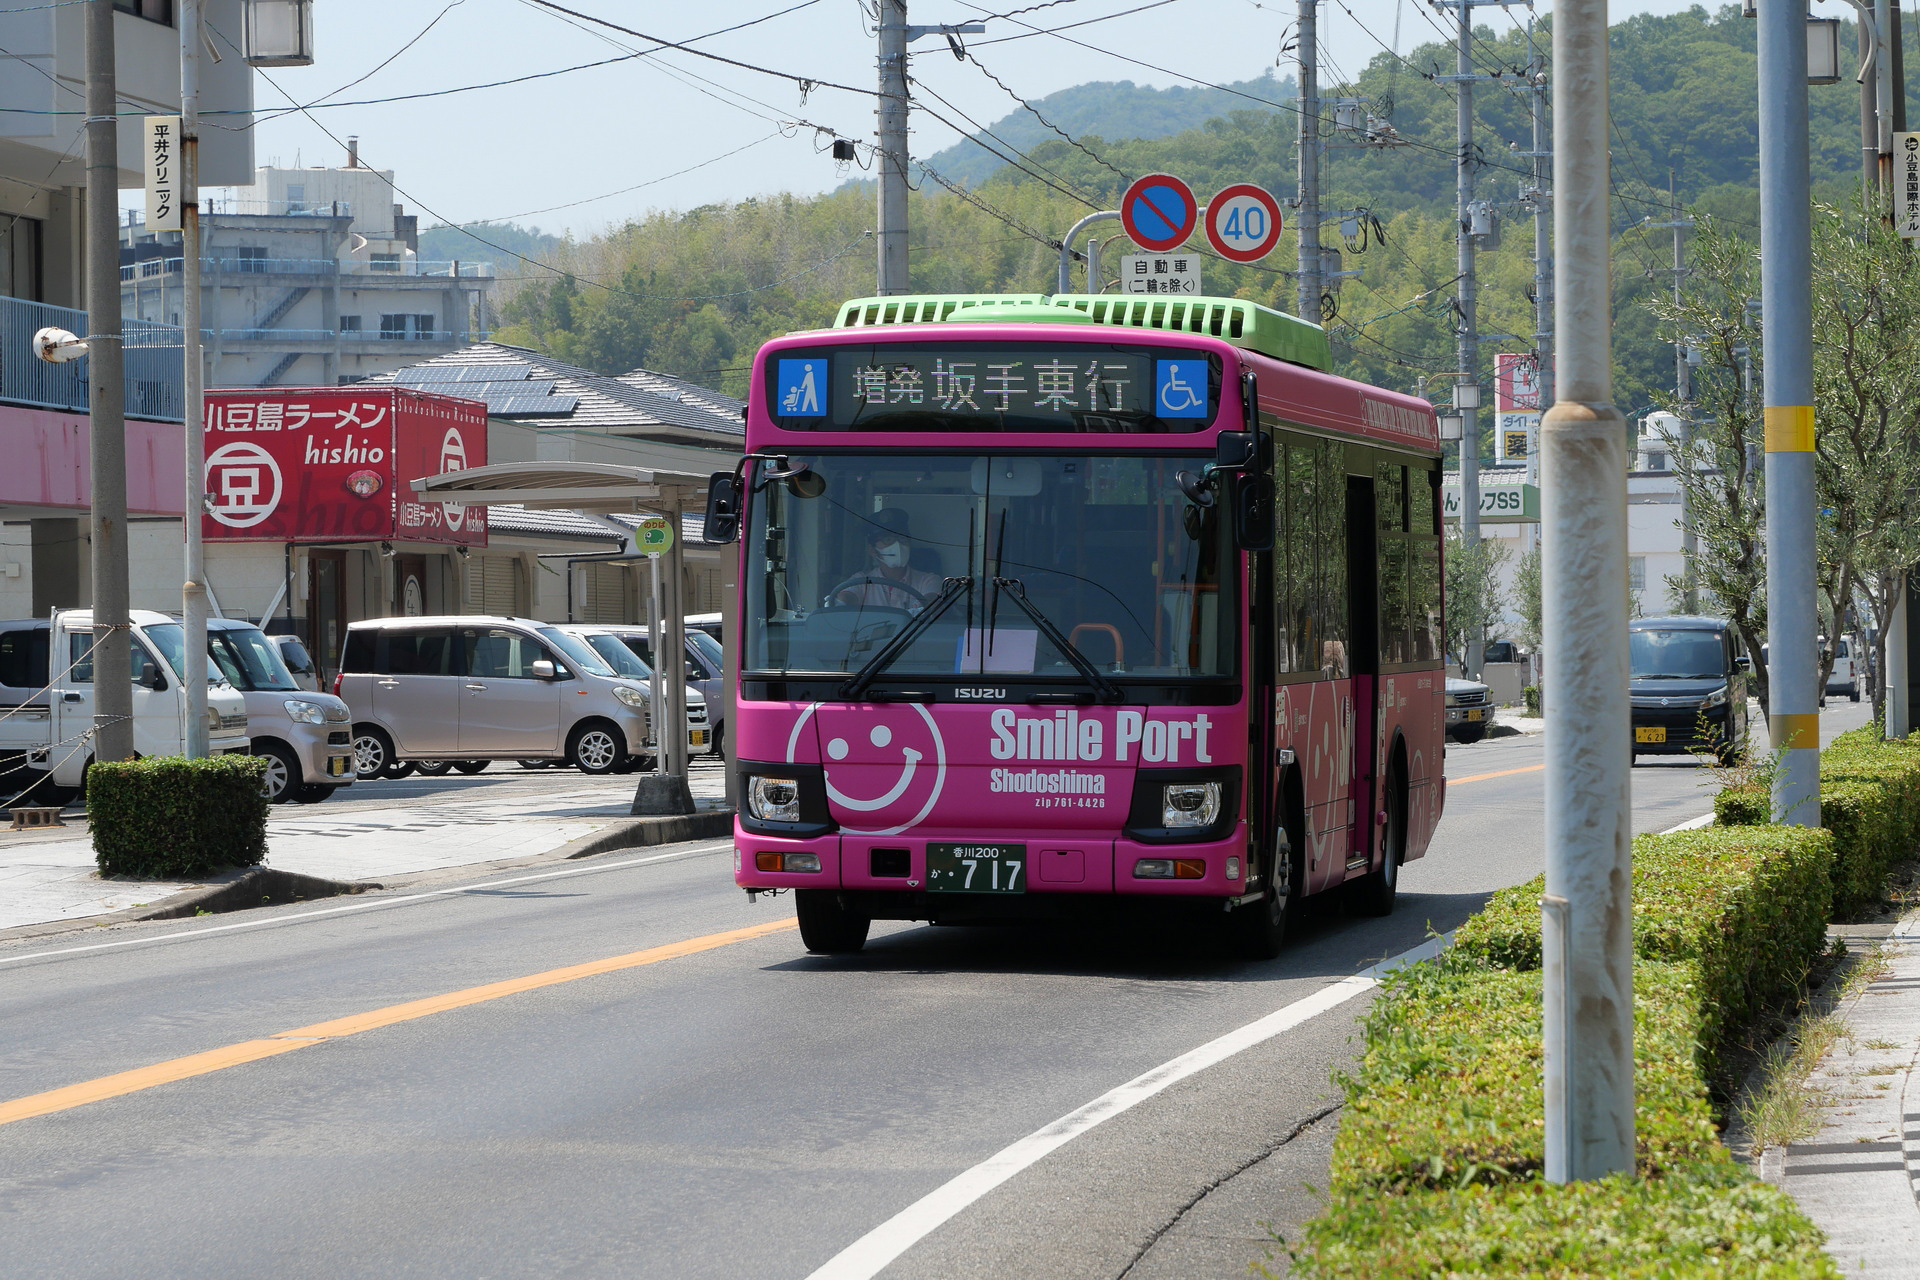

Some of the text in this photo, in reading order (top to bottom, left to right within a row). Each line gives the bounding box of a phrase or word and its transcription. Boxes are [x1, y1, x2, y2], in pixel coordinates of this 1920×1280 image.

[153, 124, 171, 220] 平井クリニック
[1906, 152, 1919, 232] 小豆島国際ホテル
[1223, 206, 1264, 241] 40
[1134, 258, 1188, 275] 自動車
[1128, 277, 1196, 294] (二輪を除く)
[204, 402, 386, 433] 小豆島ラーメン
[304, 434, 384, 465] hishio
[466, 507, 485, 534] hishio
[643, 521, 666, 529] のりば
[954, 688, 1006, 699] ISUZU
[990, 708, 1213, 763] Smile Port
[990, 768, 1105, 794] Shodoshima
[1035, 797, 1105, 808] zip 761-4426
[953, 847, 999, 858] 香川200
